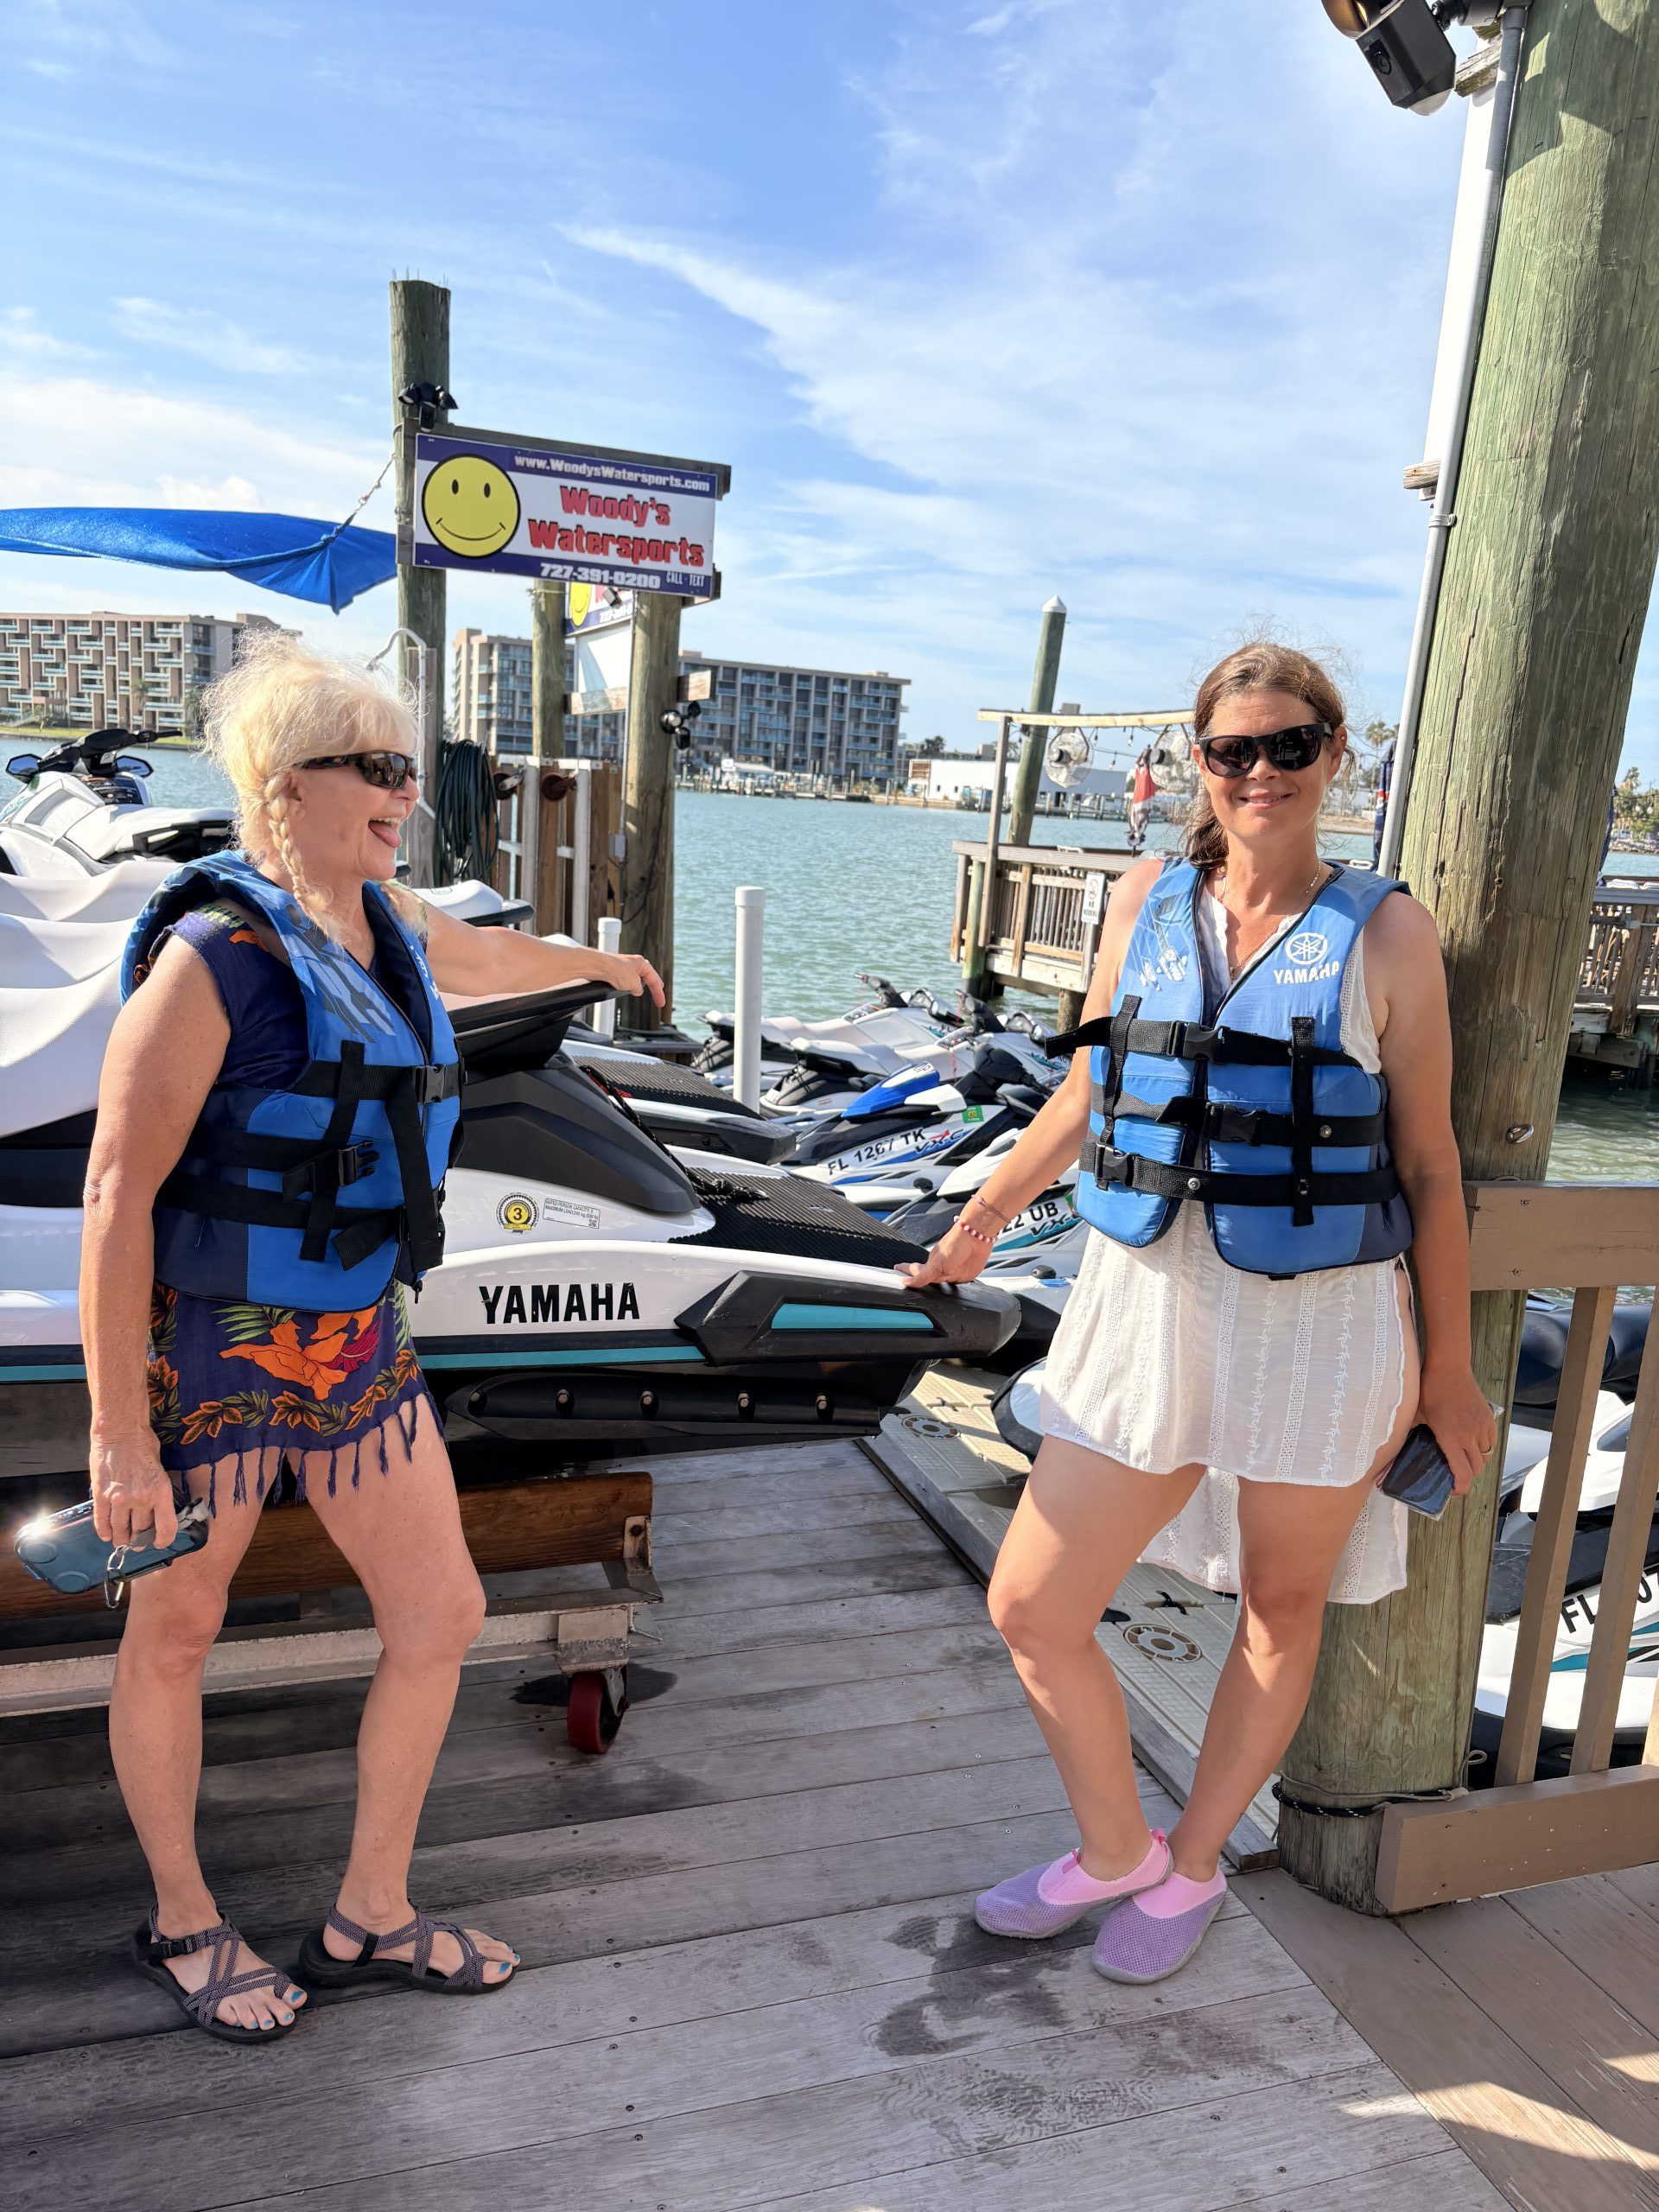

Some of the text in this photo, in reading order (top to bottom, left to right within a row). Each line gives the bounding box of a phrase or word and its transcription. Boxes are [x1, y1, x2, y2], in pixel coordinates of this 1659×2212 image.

[514, 455, 710, 492] www.WoodysWatersports.com
[559, 485, 671, 527] Woody's
[528, 518, 705, 567] Watersports
[540, 563, 705, 589] 727-391-0200 CALL TEXT
[1273, 960, 1339, 984] YAMAHA
[828, 1157, 849, 1176] FL
[900, 1127, 926, 1147] TK
[513, 1207, 522, 1221] 3
[1029, 1202, 1059, 1222] UB
[479, 1282, 640, 1325] YAMAHA
[1561, 1594, 1597, 1634] FL
